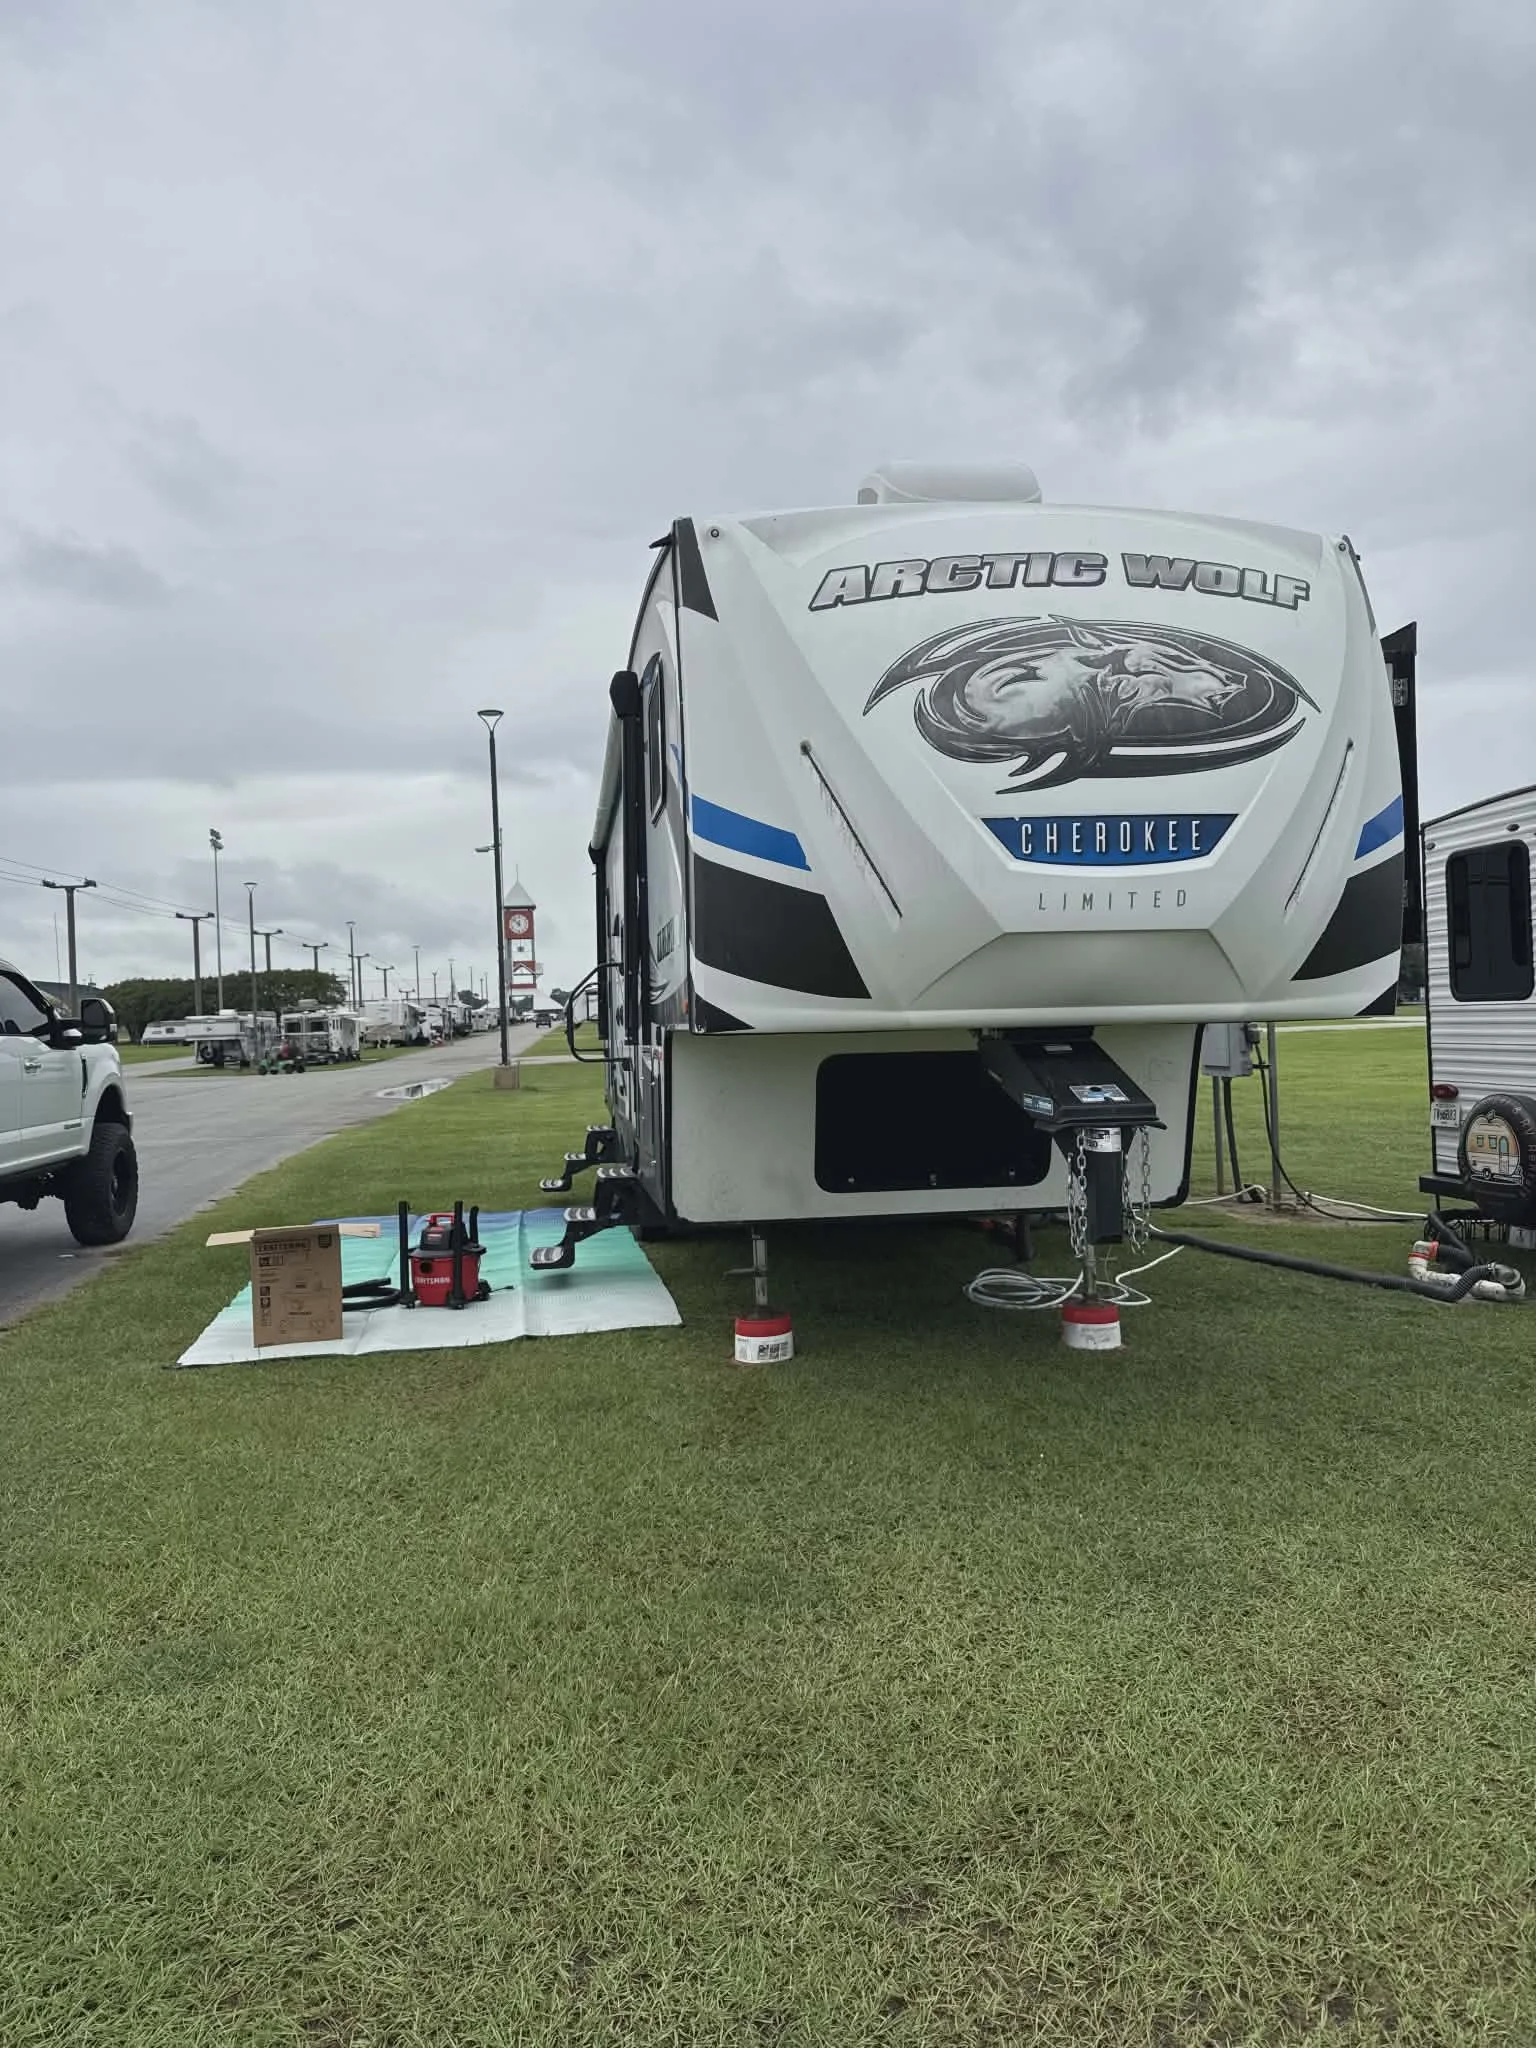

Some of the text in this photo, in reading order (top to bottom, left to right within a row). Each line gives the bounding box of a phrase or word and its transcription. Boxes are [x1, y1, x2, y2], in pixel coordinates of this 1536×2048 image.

[809, 552, 1310, 611] ARCTIC WOLF
[1019, 818, 1203, 855] CHEROKEE
[1037, 889, 1188, 912] LIMITED
